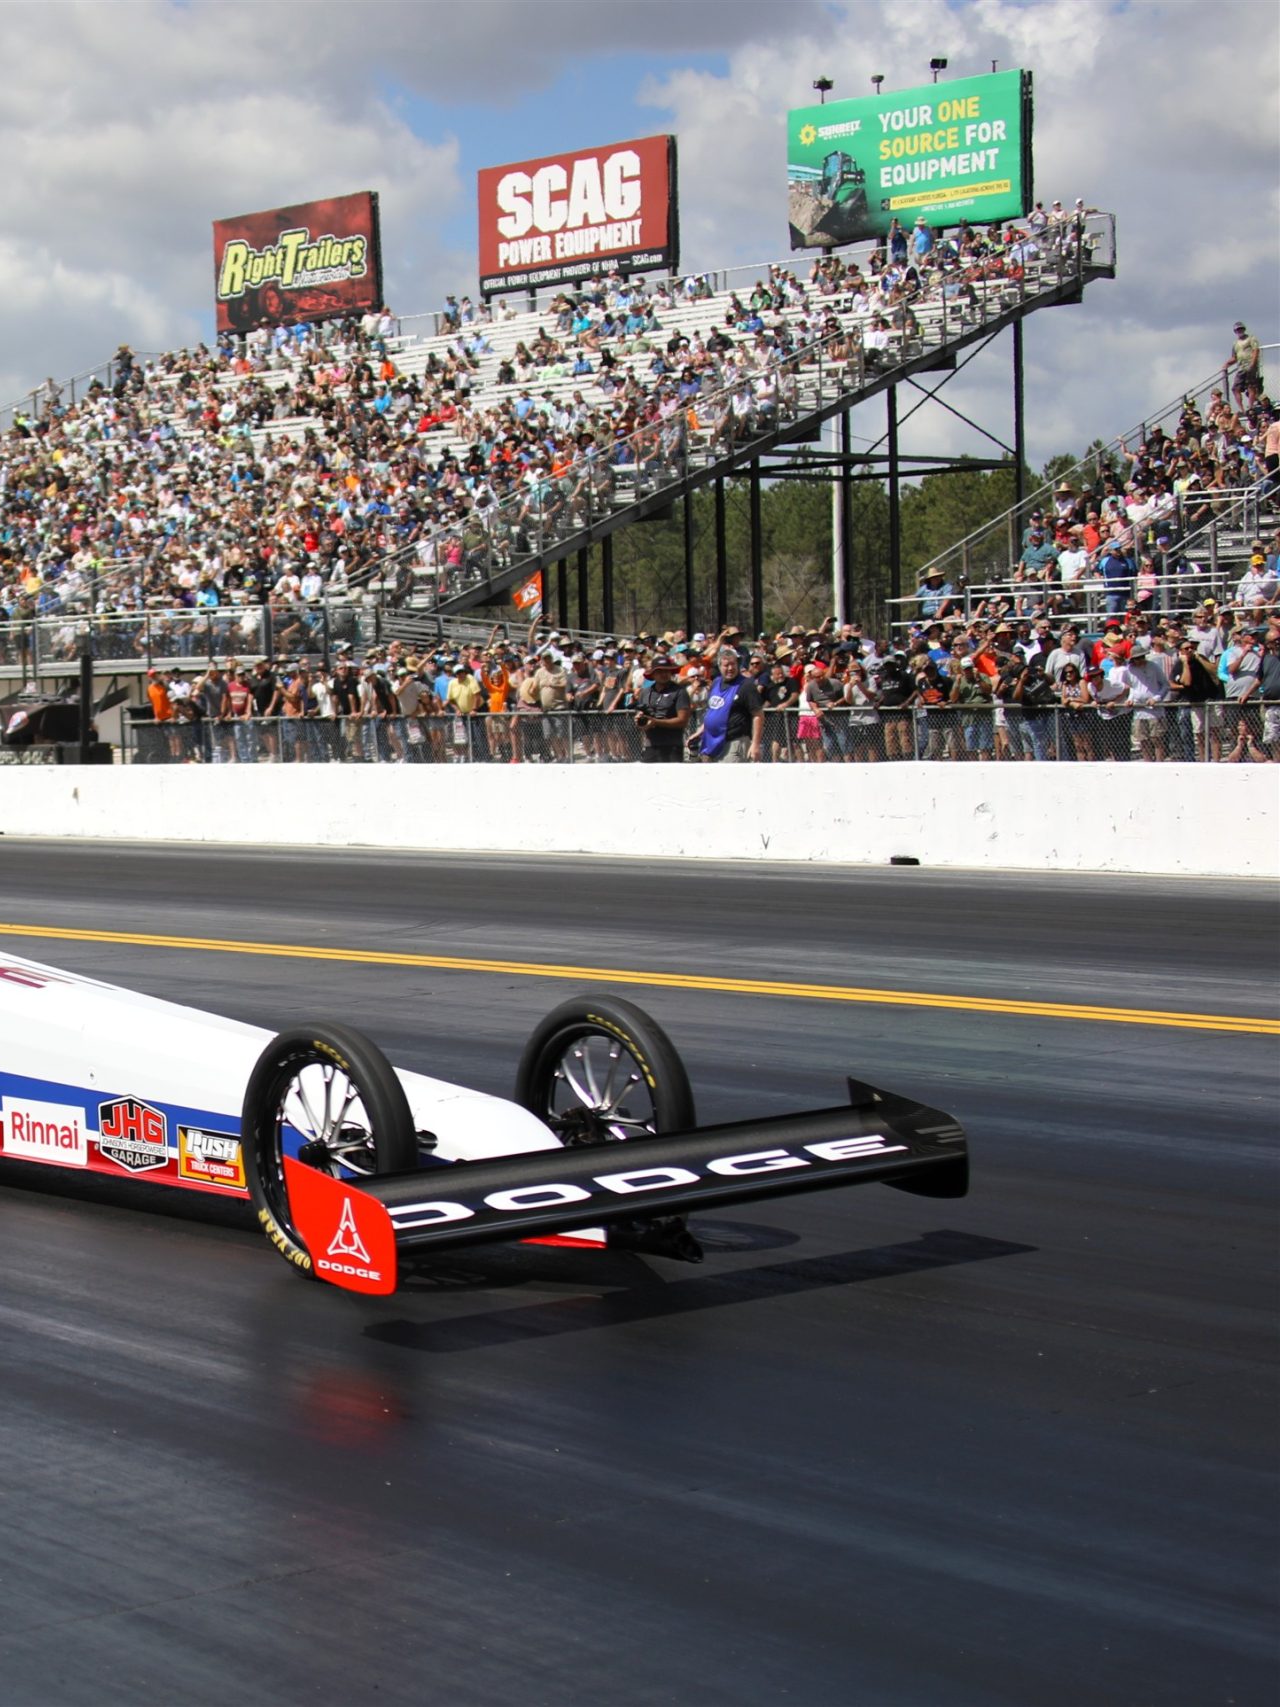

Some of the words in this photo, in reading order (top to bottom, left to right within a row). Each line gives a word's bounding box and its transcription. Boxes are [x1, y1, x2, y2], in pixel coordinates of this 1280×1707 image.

[878, 105, 932, 132] YOUR
[937, 96, 980, 121] ONE
[879, 127, 959, 160] SOURCE
[965, 120, 1006, 145] FOR
[880, 149, 999, 188] EQUIPMENT
[497, 150, 642, 239] SCAG
[498, 235, 552, 268] POWER
[555, 218, 642, 259] EQUIPMENT
[507, 273, 528, 286] POWER
[563, 263, 590, 279] PROVIDER
[592, 262, 600, 273] OF
[11, 1111, 79, 1150] Rinnai
[101, 1102, 164, 1147] JHG
[102, 1138, 127, 1147] JOHNSON'S
[111, 1148, 157, 1166] GARAGE
[186, 1129, 240, 1162] RUSH
[191, 1160, 209, 1173] TRUCK
[209, 1163, 235, 1178] CENTERS
[388, 1134, 909, 1230] DODGE
[317, 1259, 382, 1281] DODGE
